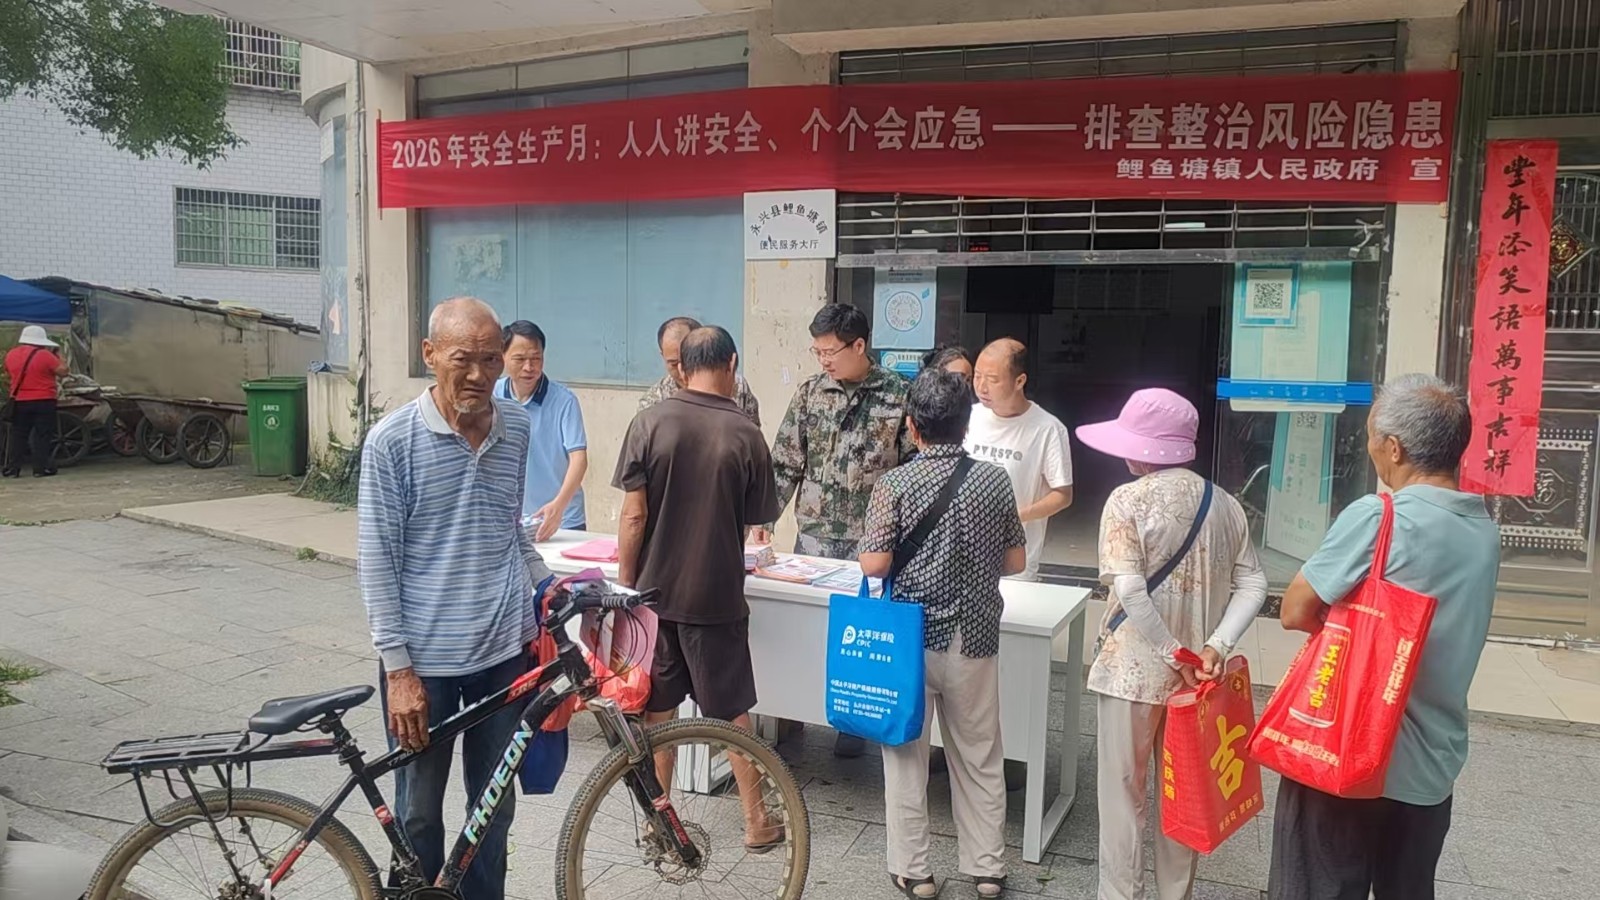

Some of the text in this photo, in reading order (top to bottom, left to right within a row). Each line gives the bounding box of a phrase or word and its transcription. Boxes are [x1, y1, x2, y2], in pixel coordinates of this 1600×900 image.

[1115, 157, 1442, 182] 鲤鱼塘镇人民政府 宣
[750, 202, 829, 236] 永兴县鲤鱼塘镇
[759, 239, 819, 251] 便民服务大厅
[857, 628, 895, 644] 太平洋保险
[1307, 644, 1342, 709] 王老吉
